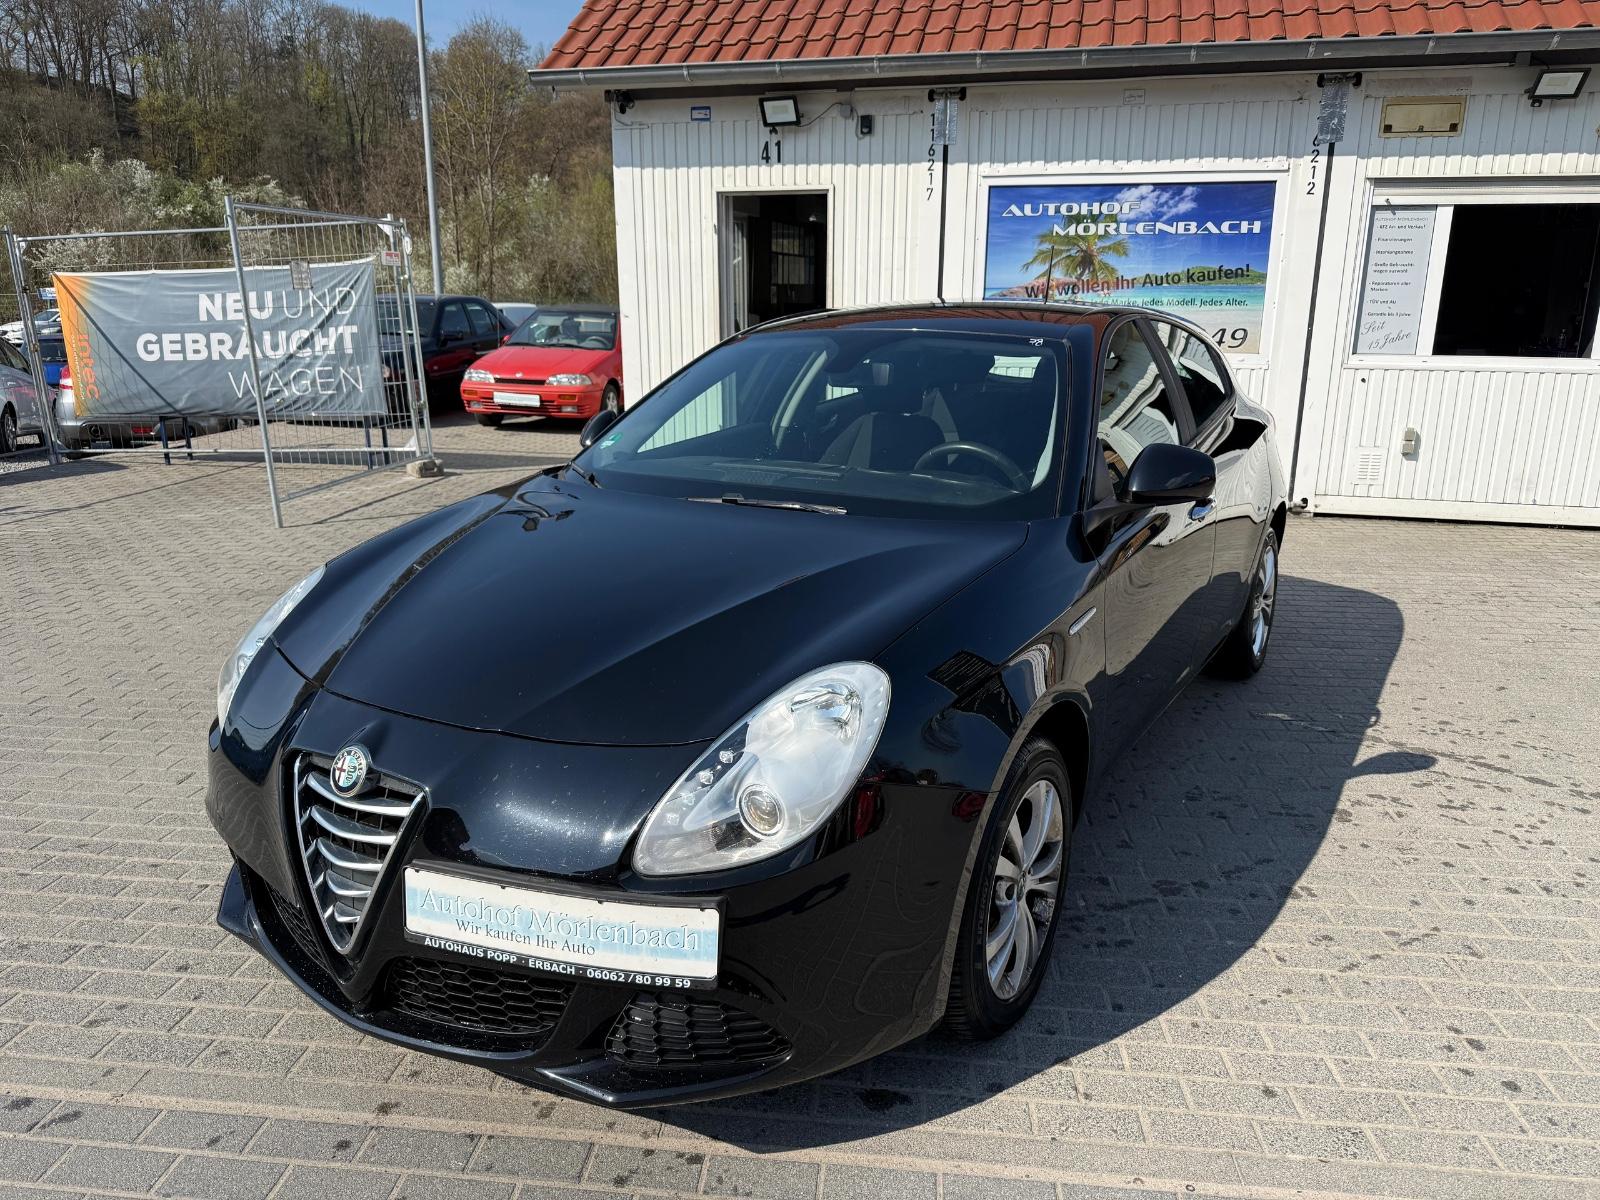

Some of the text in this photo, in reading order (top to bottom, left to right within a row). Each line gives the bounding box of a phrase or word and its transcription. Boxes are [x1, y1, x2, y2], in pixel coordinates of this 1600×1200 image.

[761, 140, 782, 164] 41
[1002, 201, 1142, 217] AUTOHOF
[1052, 219, 1262, 236] MÖRLENBACH
[1024, 264, 1250, 298] Wi wollen Ihr Auto kaufen!
[198, 287, 356, 322] NEU UND
[1166, 297, 1197, 307] Modell.
[1199, 298, 1223, 309] Jedes
[1225, 298, 1248, 307] Alter.
[136, 326, 358, 362] GEBRAUCHT
[228, 365, 364, 399] WAGEN
[420, 887, 700, 953] Autohof Mörlenbach
[455, 918, 596, 956] Wir kaufen Ihr Auto
[424, 937, 485, 958] AUTOHAUS
[487, 950, 517, 965] POPP
[528, 958, 576, 976] ERBACH
[655, 976, 672, 987] 99
[675, 977, 691, 989] 59
